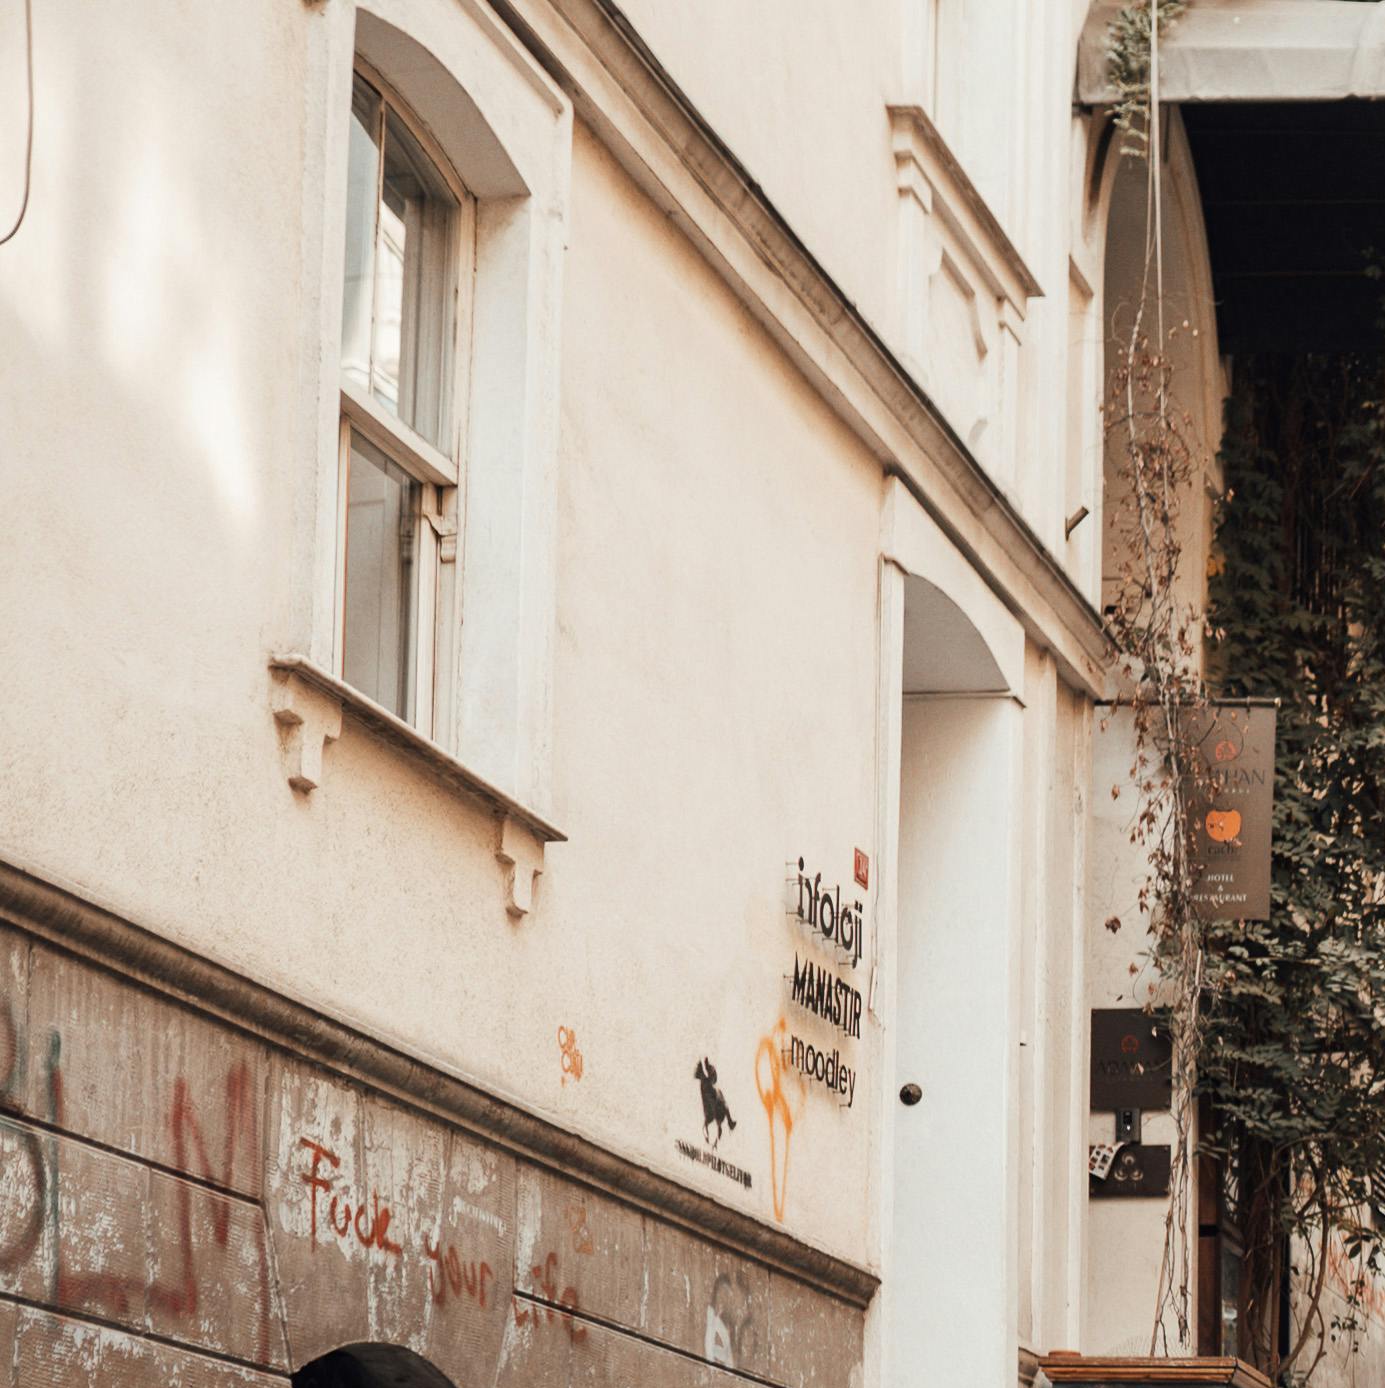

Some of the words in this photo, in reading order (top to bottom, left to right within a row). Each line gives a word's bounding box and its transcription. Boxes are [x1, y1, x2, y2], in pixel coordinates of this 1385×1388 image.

[792, 951, 861, 1040] MANASTIR
[791, 1034, 856, 1108] moodley
[300, 1137, 402, 1254] Fuck
